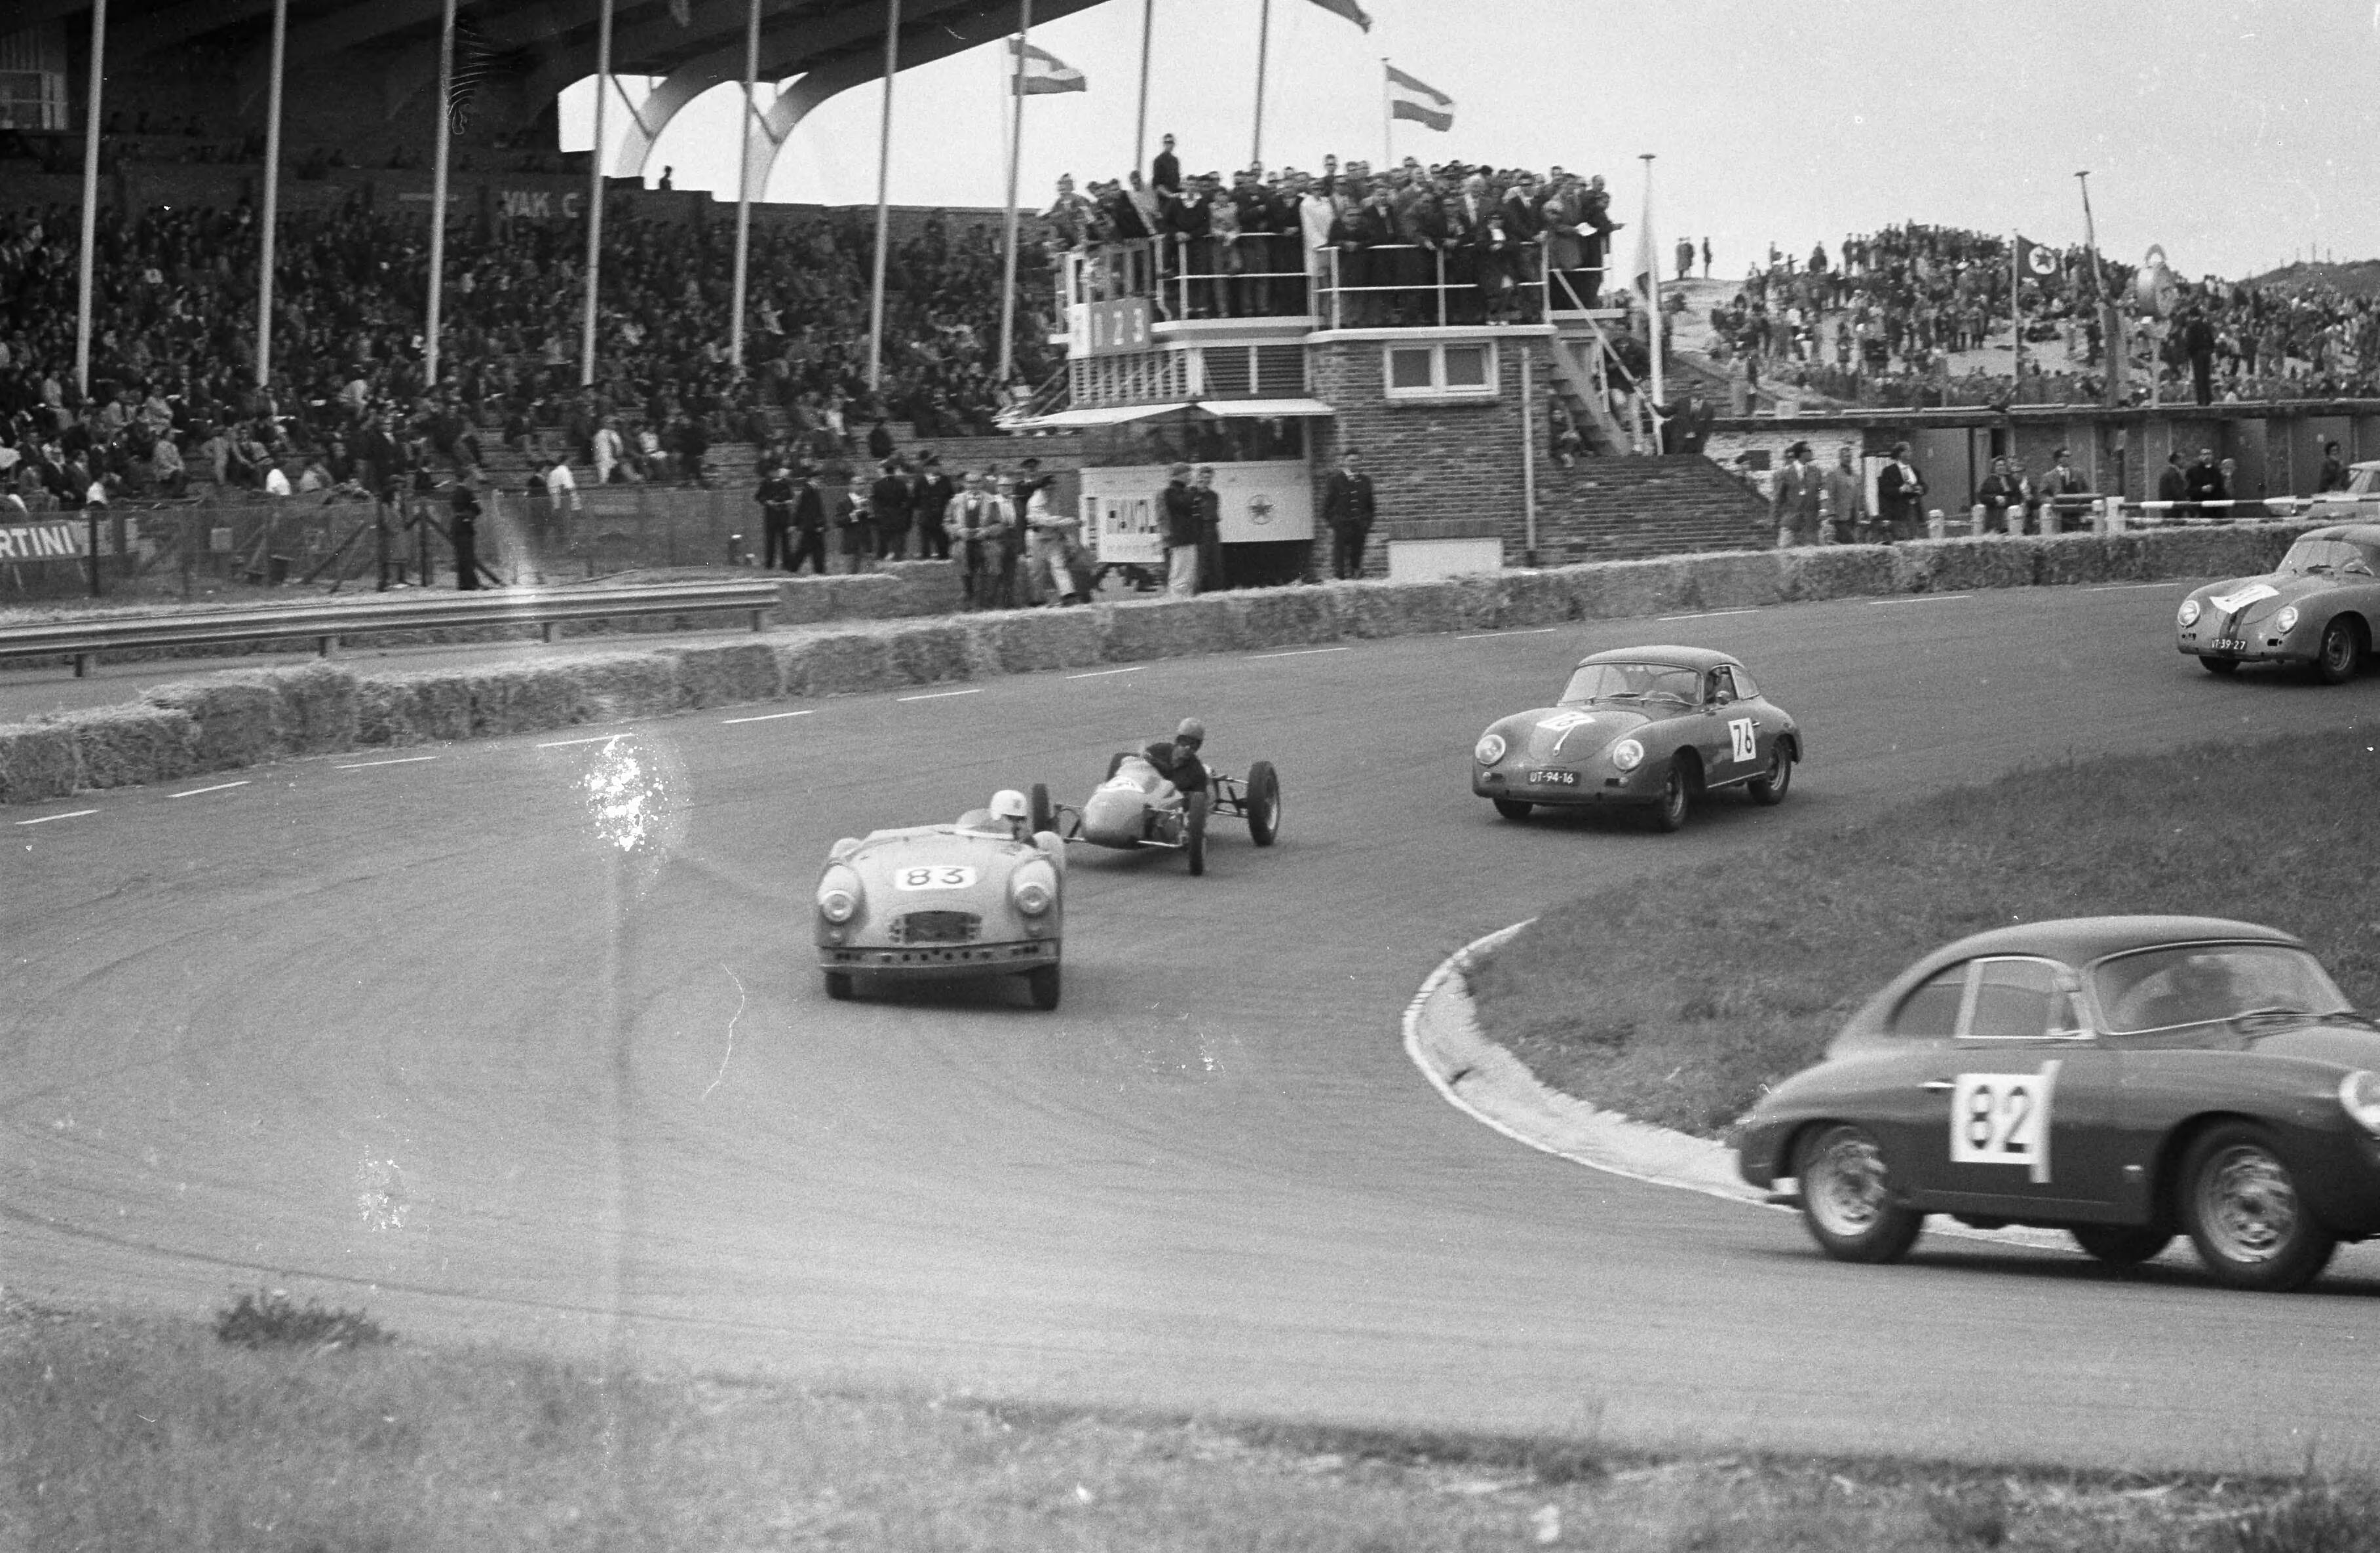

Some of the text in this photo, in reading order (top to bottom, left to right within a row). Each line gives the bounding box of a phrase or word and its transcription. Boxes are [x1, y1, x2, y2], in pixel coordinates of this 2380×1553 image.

[563, 191, 579, 218] C
[1733, 722, 1753, 756] 76
[907, 867, 965, 886] 83
[1967, 1084, 2033, 1154] 82
